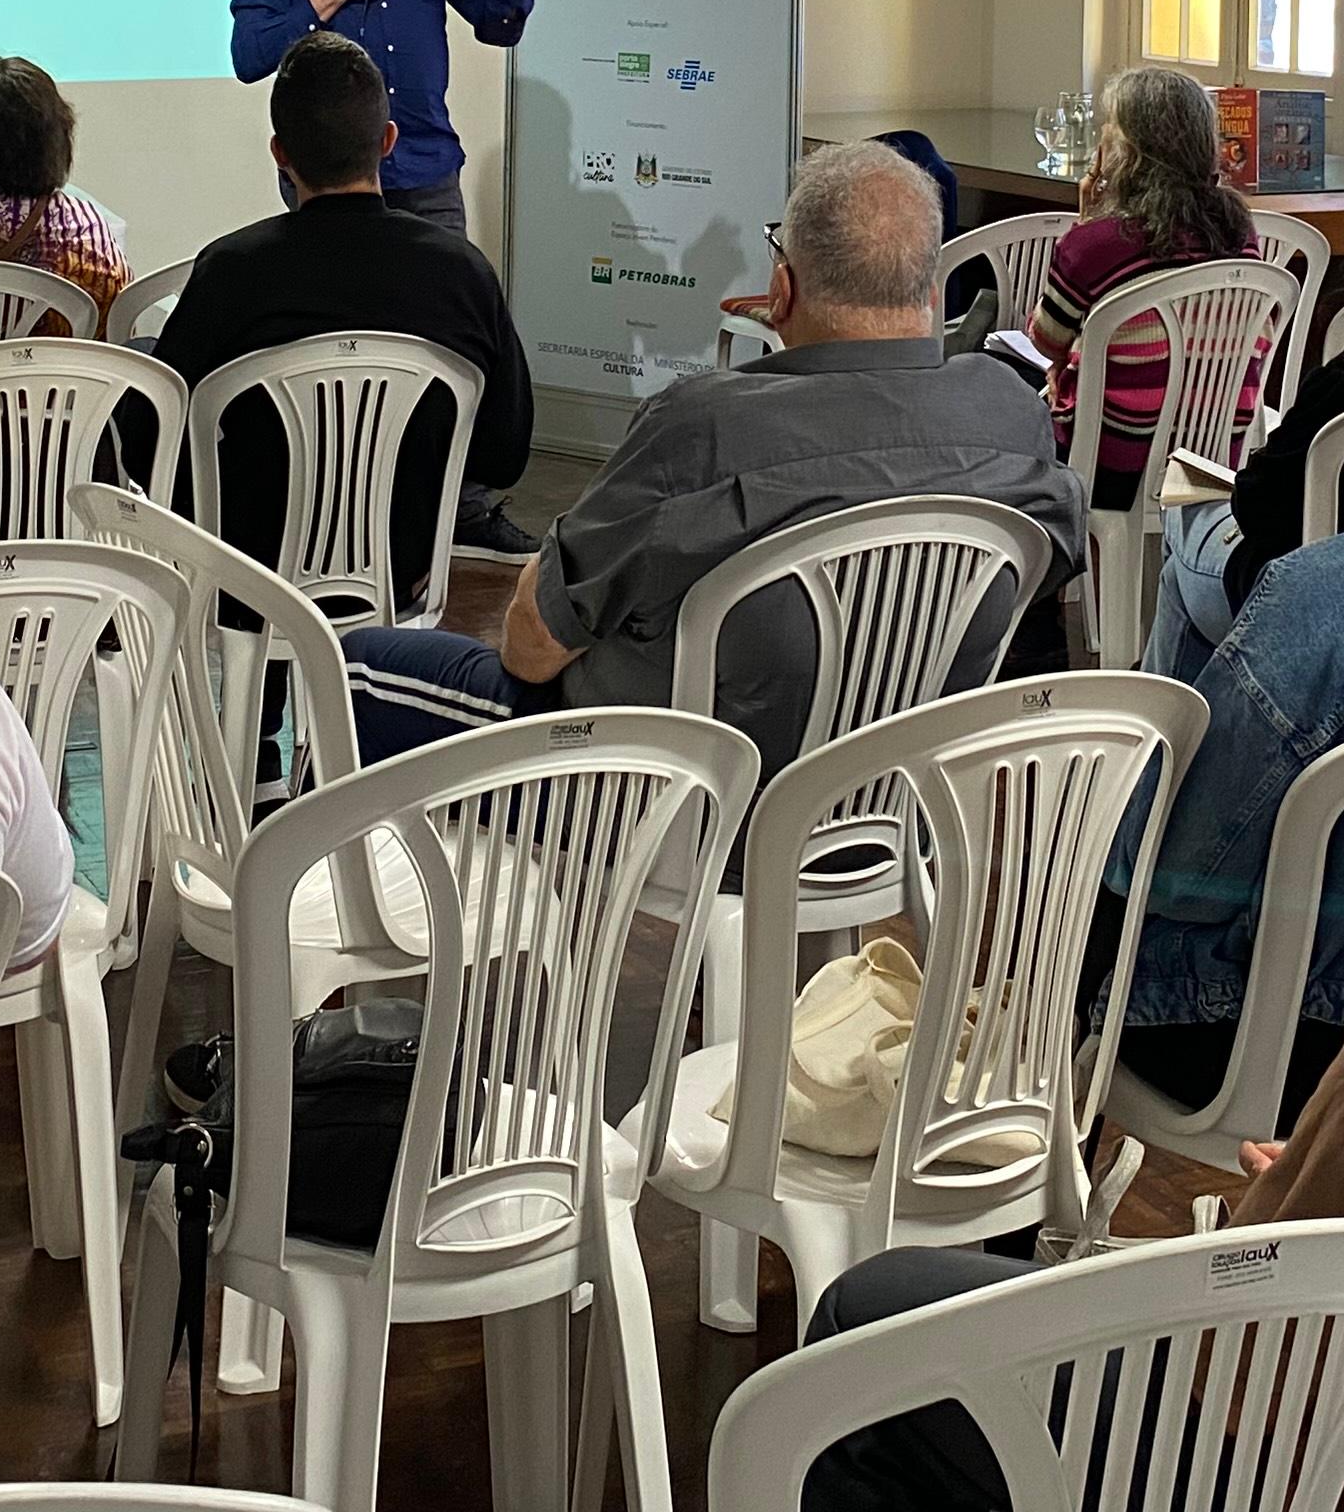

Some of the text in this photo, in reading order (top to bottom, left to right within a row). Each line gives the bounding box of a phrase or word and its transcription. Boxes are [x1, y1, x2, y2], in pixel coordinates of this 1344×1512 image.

[667, 68, 715, 82] SEBRAE
[619, 269, 696, 288] PETROBRAS
[538, 342, 644, 365] SECRETARIA ESPECIAL DA
[603, 363, 644, 377] CULTURA
[1241, 1240, 1282, 1263] lauX
